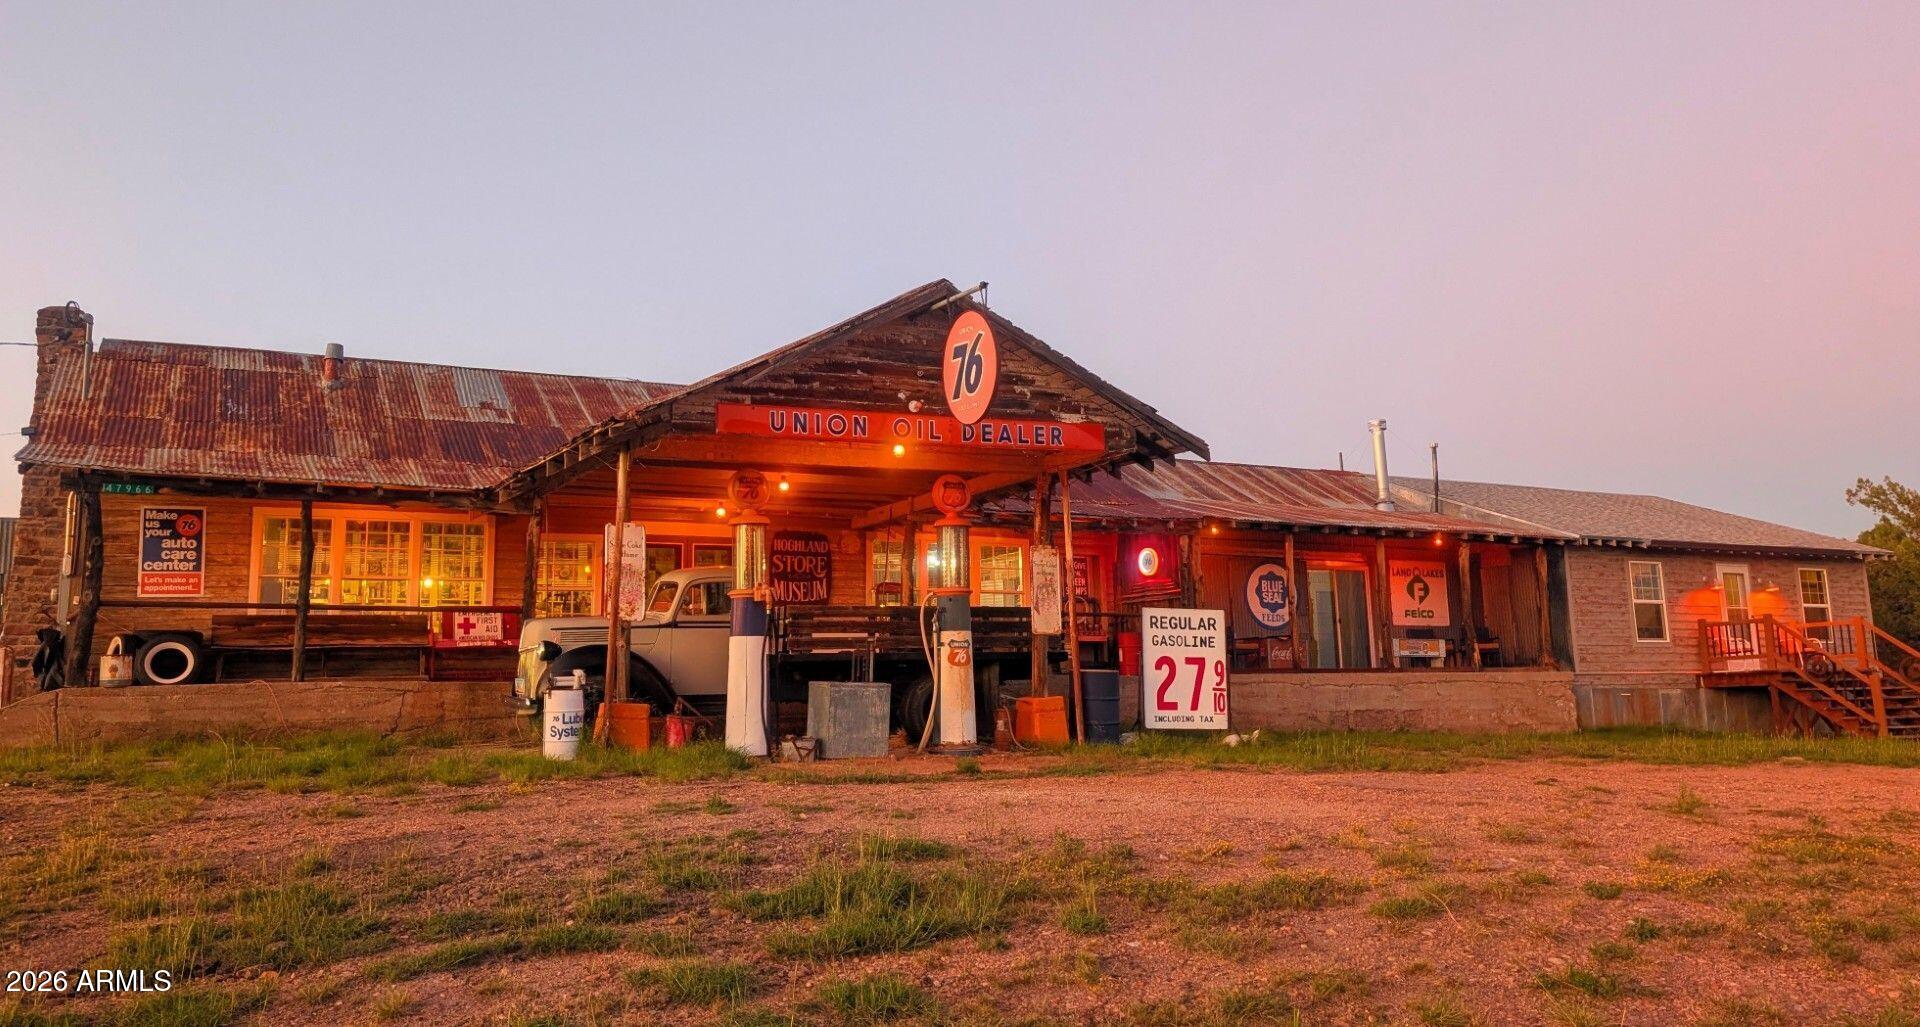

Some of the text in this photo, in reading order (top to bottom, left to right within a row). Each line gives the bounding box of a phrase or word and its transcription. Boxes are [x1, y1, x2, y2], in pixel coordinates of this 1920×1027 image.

[951, 329, 984, 402] 76
[769, 410, 1064, 447] UNION OIL DEALER
[145, 510, 178, 520] Make
[145, 520, 160, 528] us
[182, 519, 196, 530] 76
[144, 528, 172, 537] your
[161, 537, 198, 549] auto
[160, 549, 197, 560] care
[143, 559, 197, 571] center
[772, 554, 828, 577] STORE
[1422, 568, 1445, 578] LAKES
[772, 579, 828, 602] MUSEUM
[1261, 580, 1284, 592] BLUE
[1262, 592, 1284, 604] SEAL
[1149, 615, 1217, 631] REGULAR
[1261, 613, 1286, 622] FEEDS
[485, 625, 498, 633] AID
[949, 640, 970, 648] UNION
[1151, 635, 1216, 649] GASOLINE
[952, 648, 967, 663] 76
[1154, 655, 1206, 711] 27
[1154, 715, 1195, 723] INCLUDING
[550, 725, 579, 740] Syste
